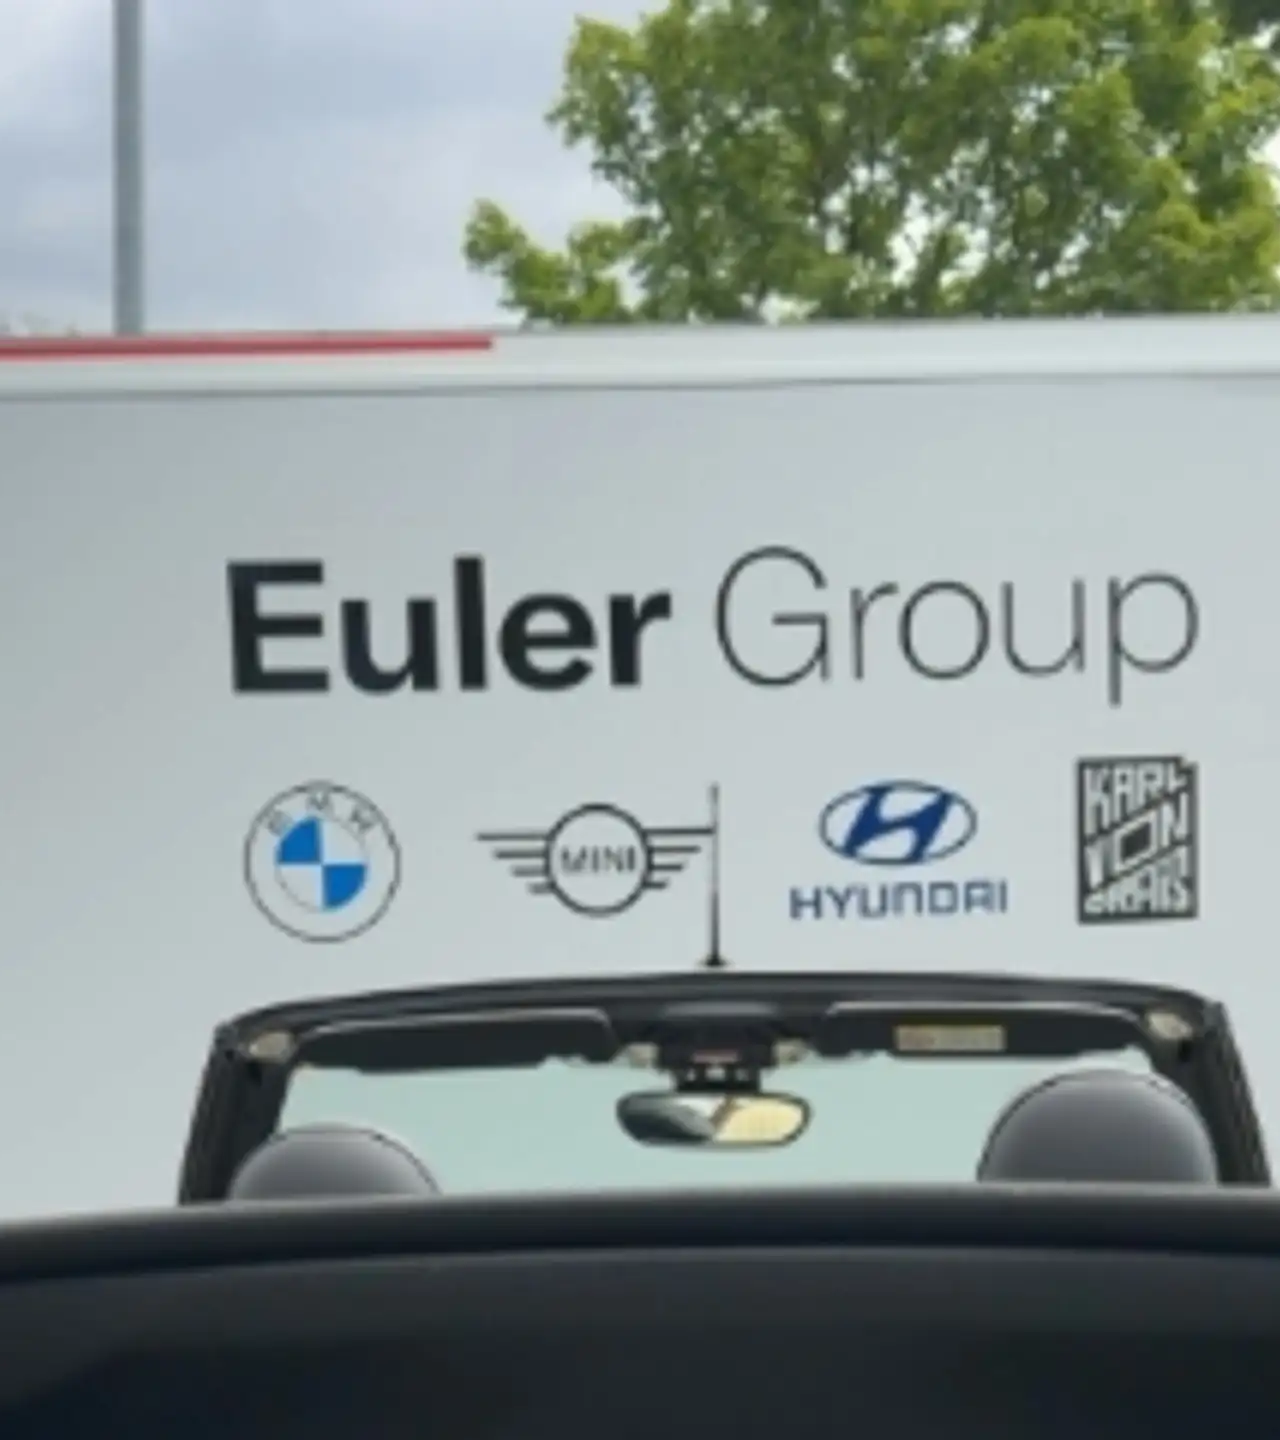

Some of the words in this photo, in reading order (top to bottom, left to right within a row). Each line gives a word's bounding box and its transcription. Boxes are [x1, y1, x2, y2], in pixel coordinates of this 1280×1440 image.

[226, 556, 672, 695] Euler
[716, 546, 1198, 705] Group
[1083, 763, 1188, 837] KARL
[561, 844, 636, 874] MINI
[790, 881, 1007, 919] HYUNDAI
